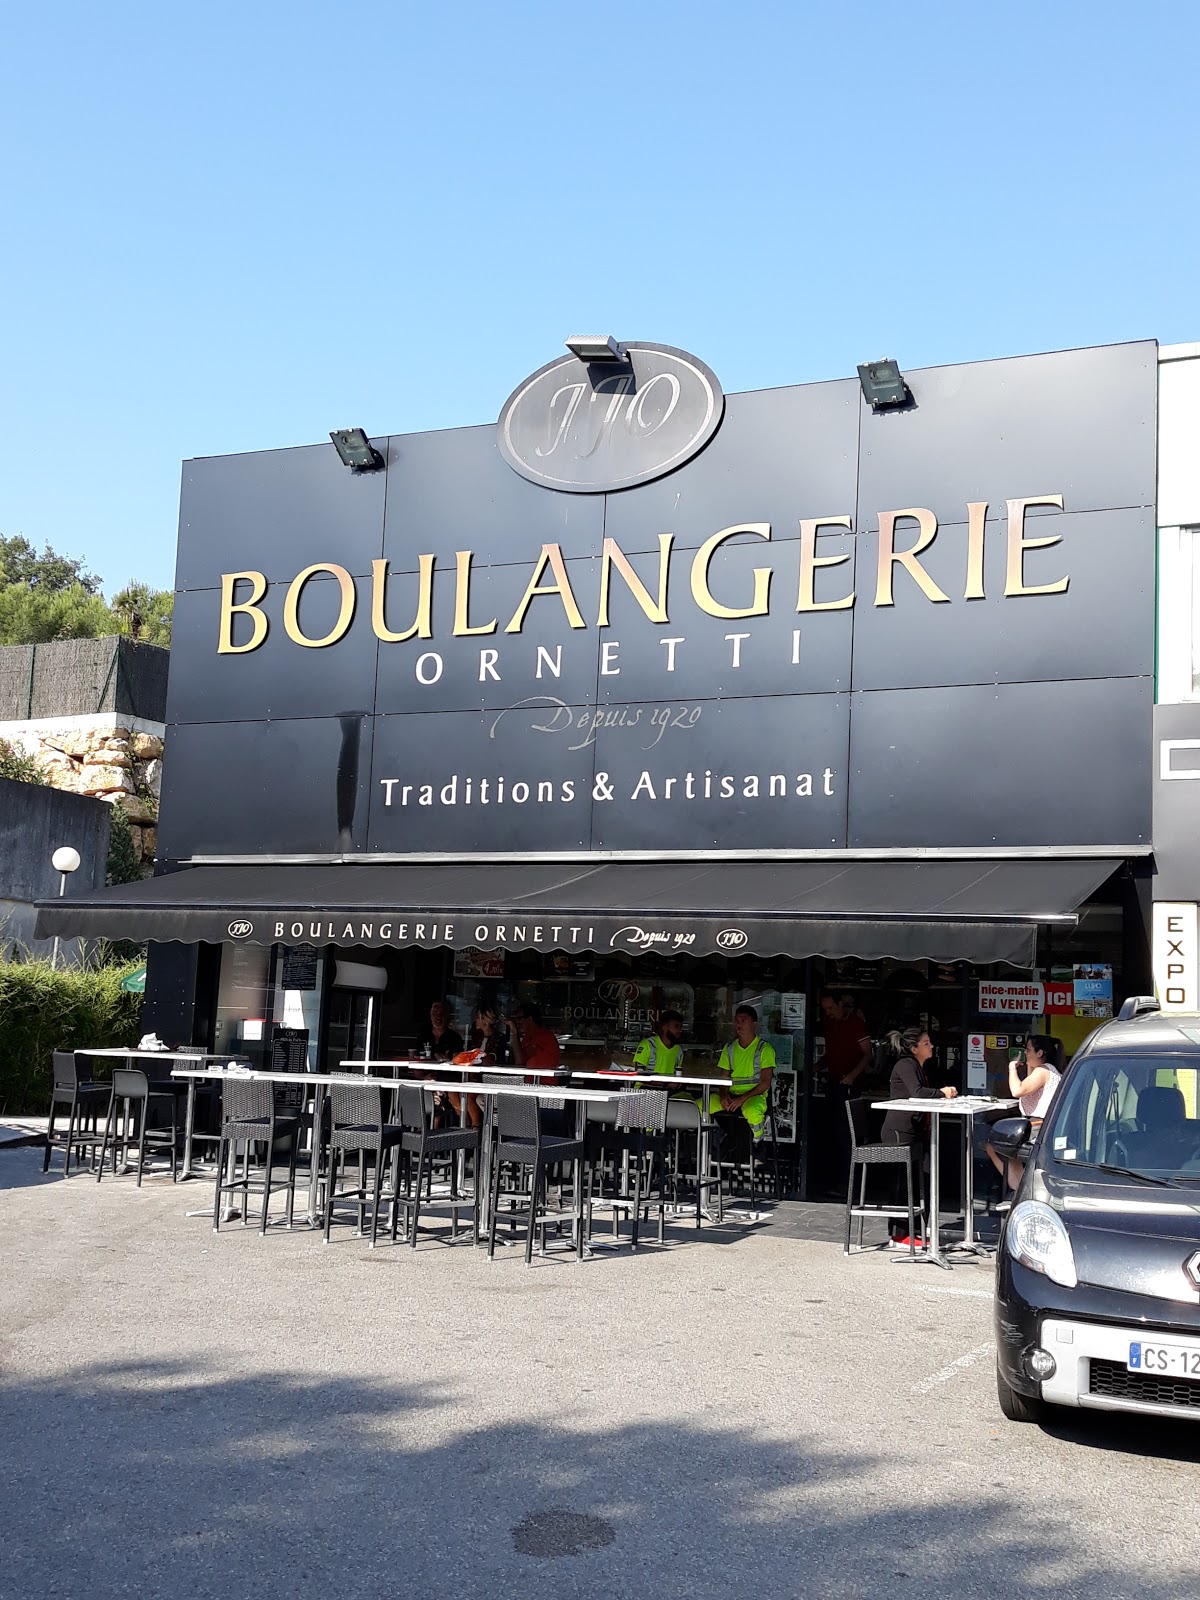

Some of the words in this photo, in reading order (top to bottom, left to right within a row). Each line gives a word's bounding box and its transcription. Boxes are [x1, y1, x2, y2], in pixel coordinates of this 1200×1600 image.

[218, 494, 1070, 655] BOULANGERIE
[415, 629, 801, 685] ORNETTI
[490, 696, 642, 750] Depuis
[641, 706, 702, 750] 1920
[380, 774, 576, 806] Traditions
[592, 771, 616, 801] &
[630, 767, 836, 800] Artisanat
[274, 922, 455, 941] BOULANGERIE
[474, 925, 595, 943] ORNETTI
[610, 926, 671, 948] Depuis
[672, 933, 696, 949] 1920
[1166, 916, 1186, 1004] EXPO
[564, 1006, 666, 1022] BOULANGERI
[981, 998, 996, 1010] EN
[1000, 999, 1039, 1011] VENTE
[1047, 991, 1072, 1006] ICI
